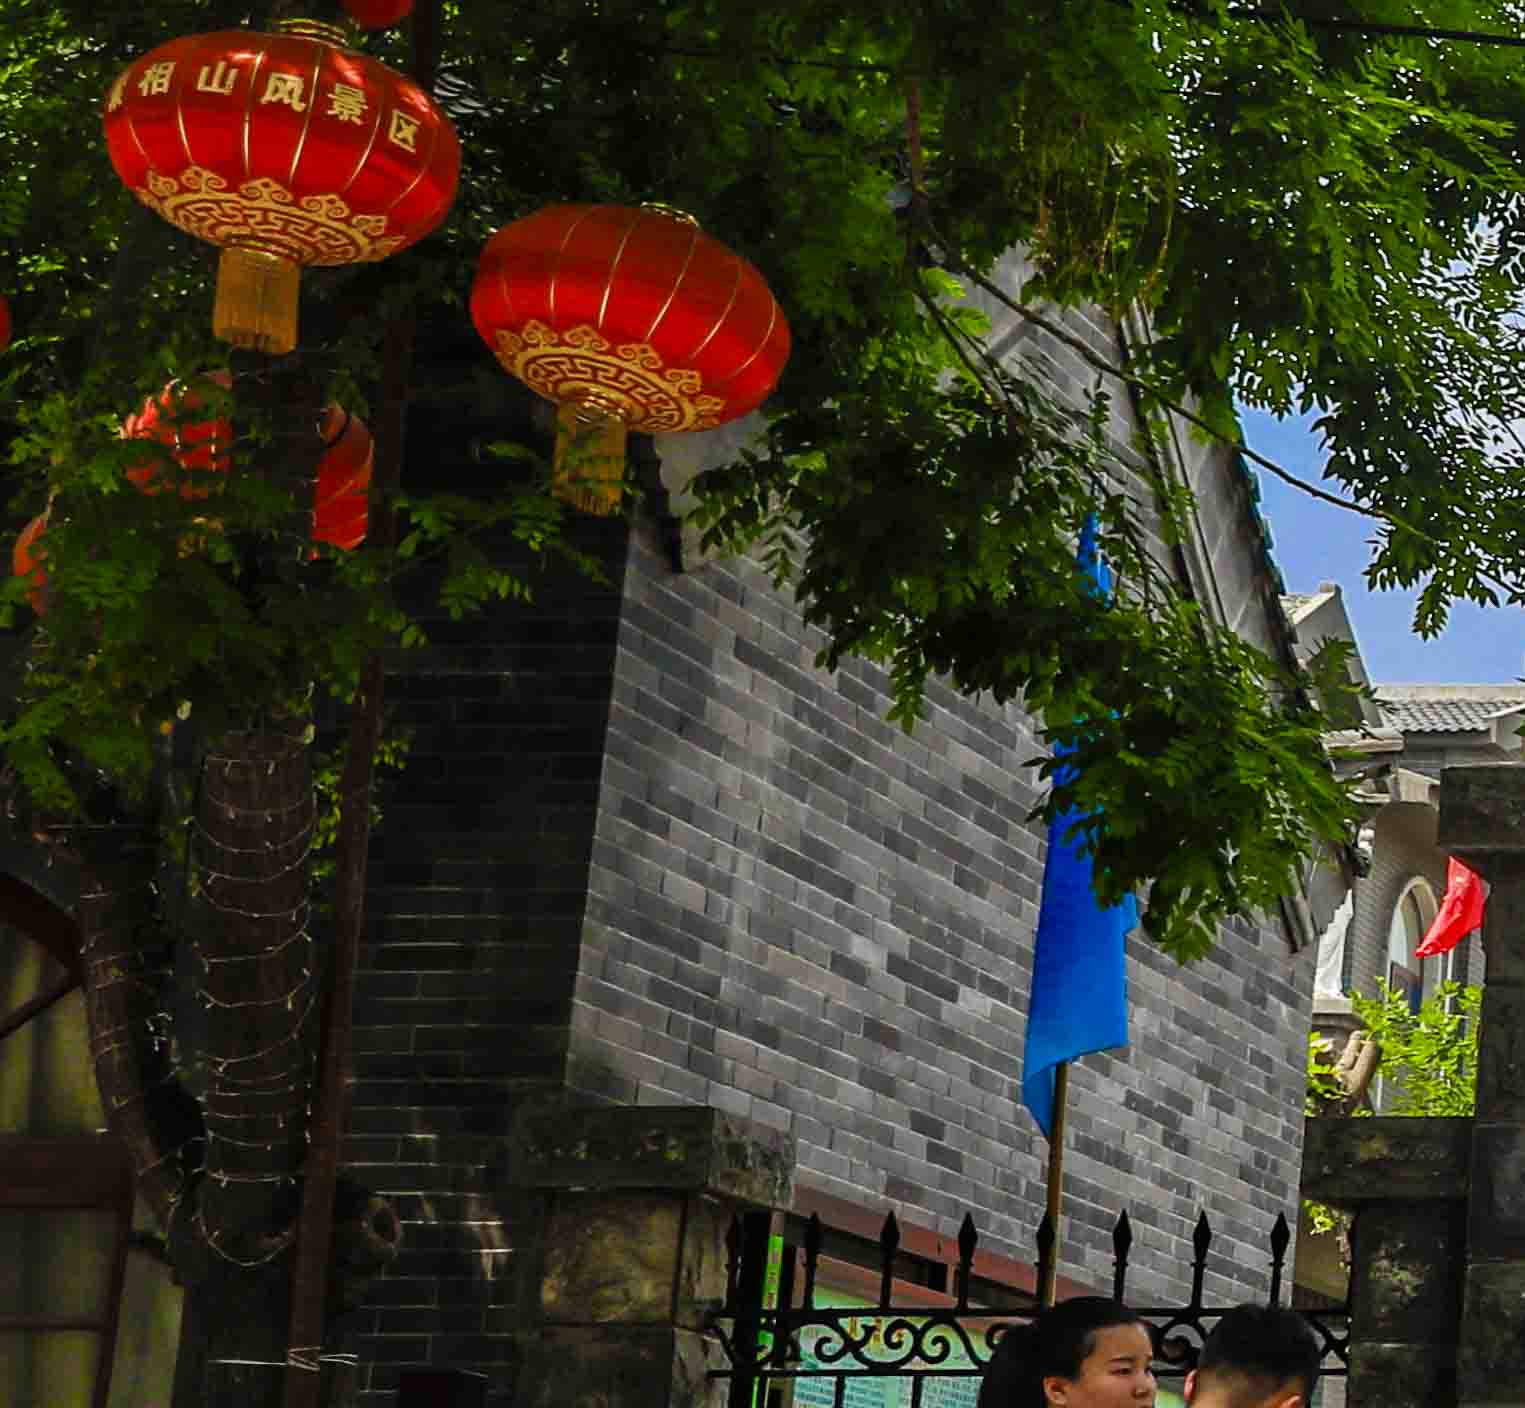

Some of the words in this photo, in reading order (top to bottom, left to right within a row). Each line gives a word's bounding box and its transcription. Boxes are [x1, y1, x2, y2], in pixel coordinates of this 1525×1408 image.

[108, 60, 420, 153] 相山风景区
